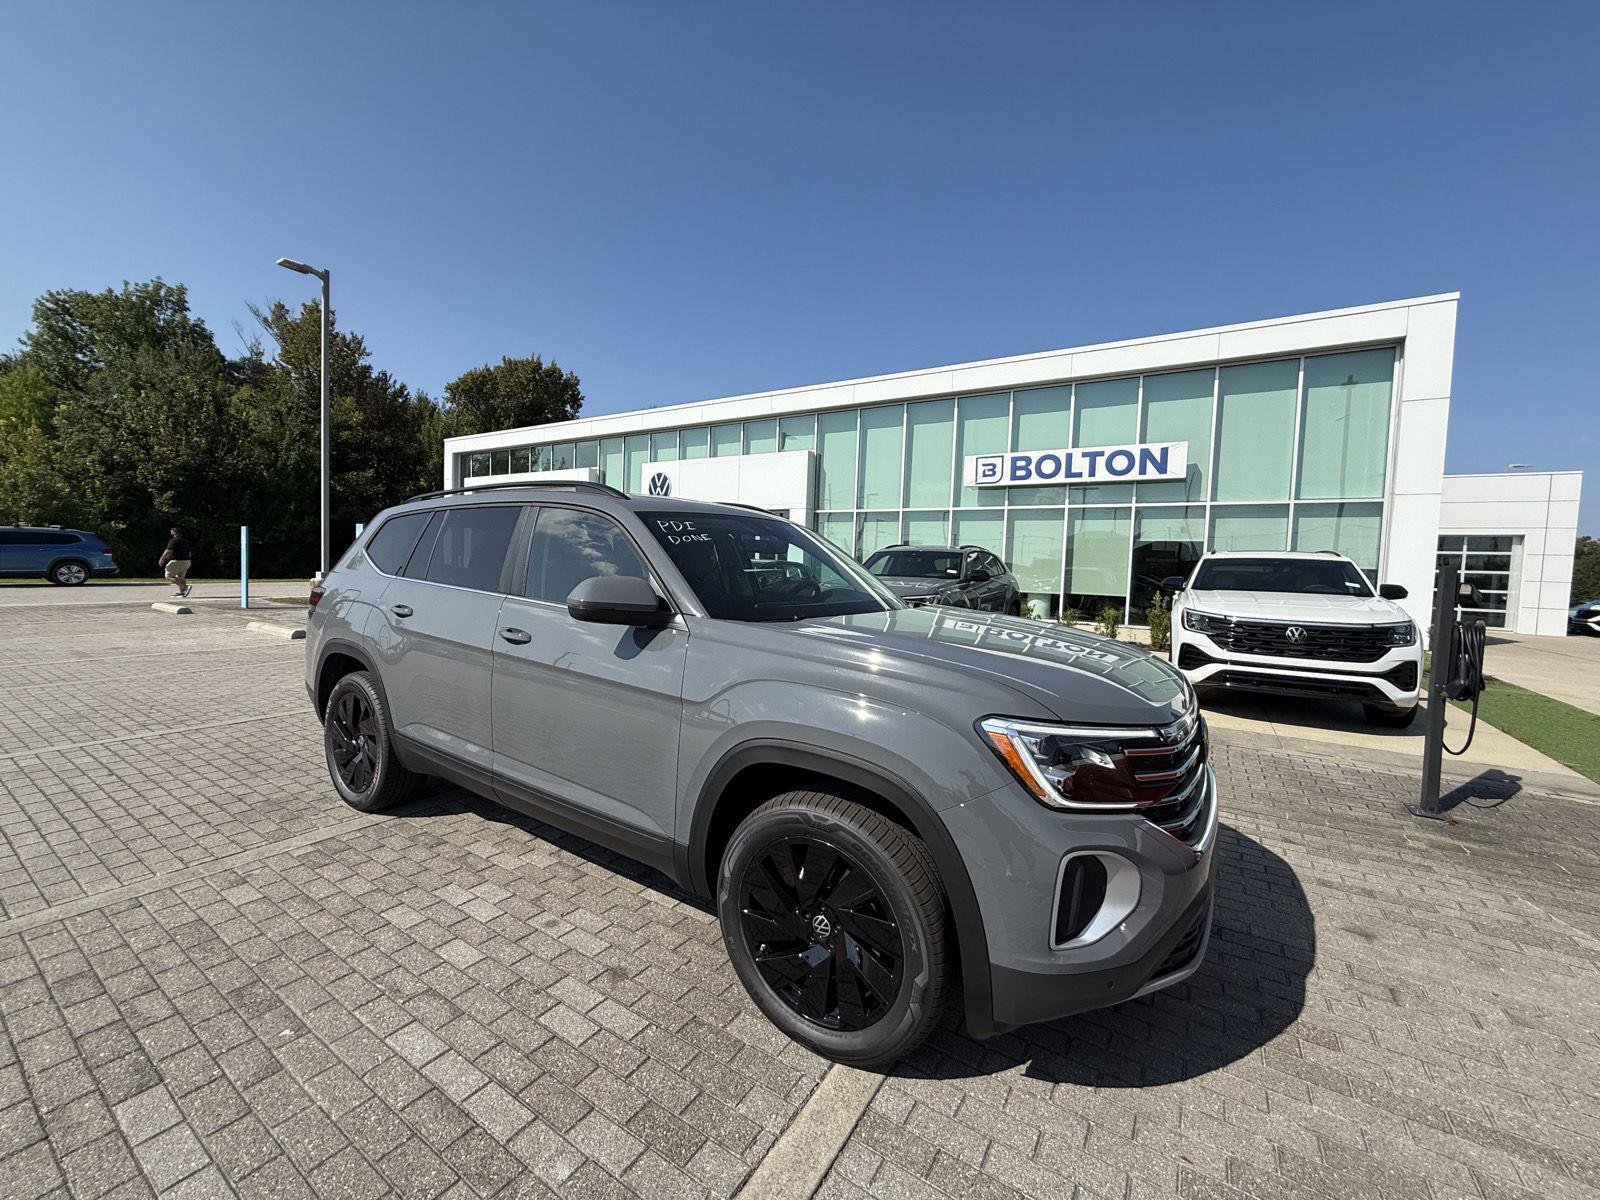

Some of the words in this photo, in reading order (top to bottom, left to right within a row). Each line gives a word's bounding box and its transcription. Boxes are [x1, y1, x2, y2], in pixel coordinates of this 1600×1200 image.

[1010, 446, 1169, 481] BOLTON
[657, 520, 696, 533] PDI
[667, 533, 712, 545] DONE
